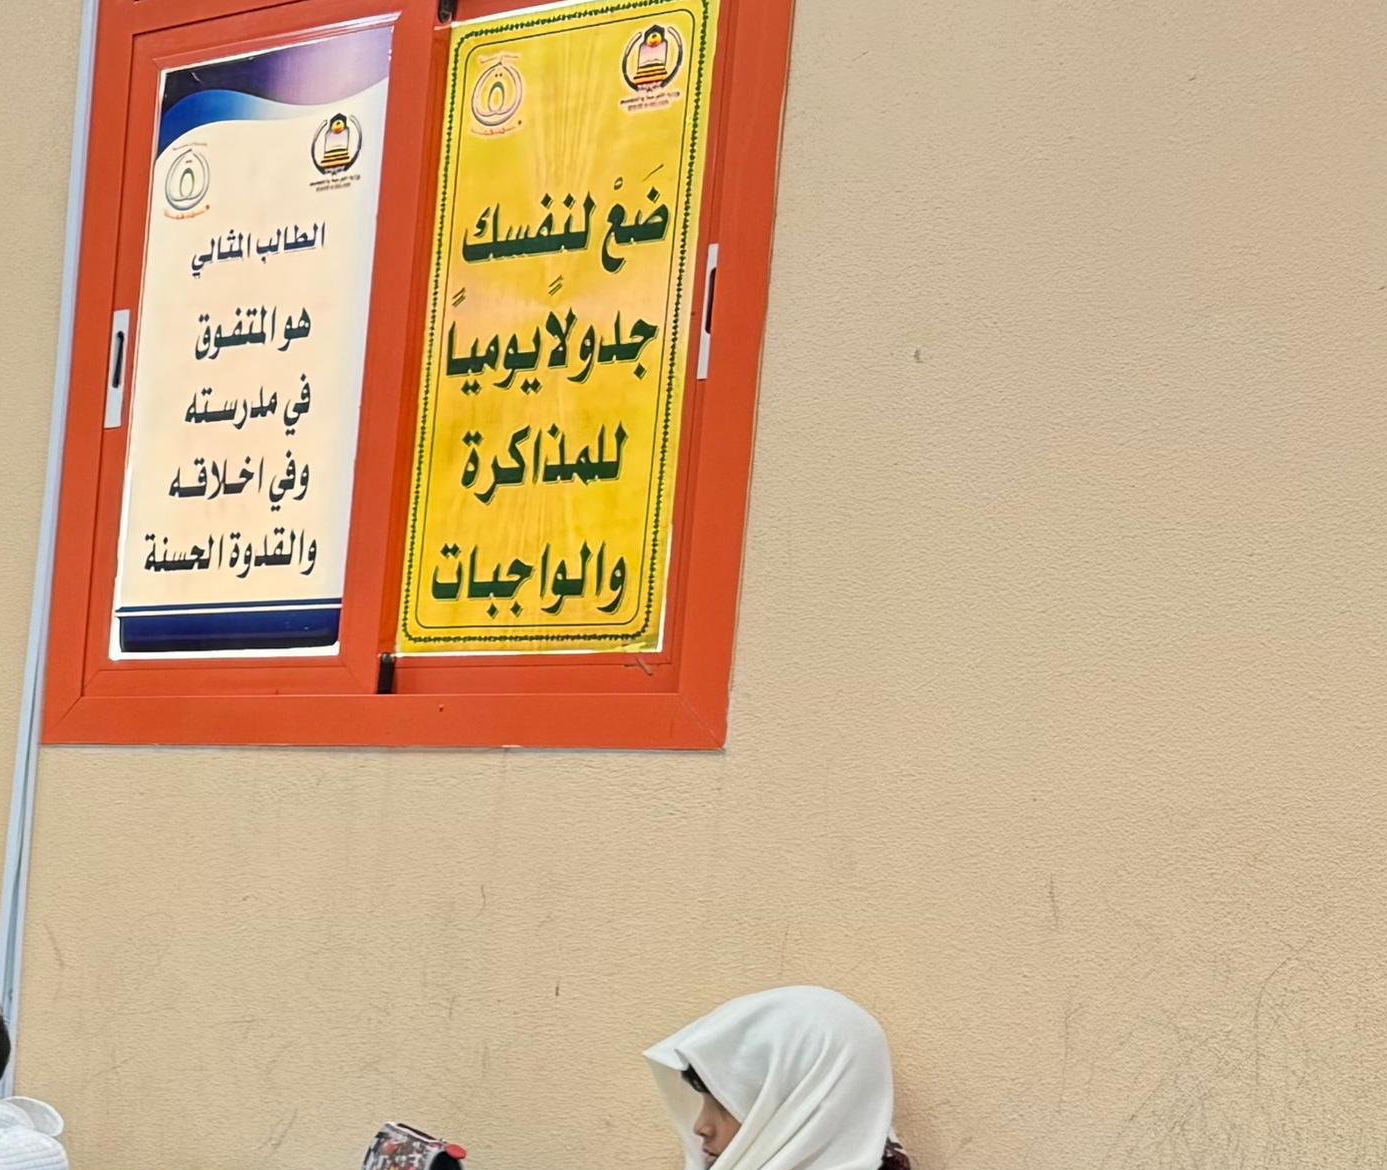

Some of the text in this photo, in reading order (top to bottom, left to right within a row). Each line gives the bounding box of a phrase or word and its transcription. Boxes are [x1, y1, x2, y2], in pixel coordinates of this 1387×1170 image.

[191, 222, 325, 278] الطالب المثالي
[461, 190, 596, 265] لنفسك
[194, 304, 311, 361] هو المتفوق
[185, 373, 311, 437] في مدرسته
[168, 449, 310, 512] وفي اخلاقه
[461, 419, 628, 506] للمذاكرة
[144, 526, 318, 579] والقدوة الحسنة
[431, 539, 627, 620] والواجبات
